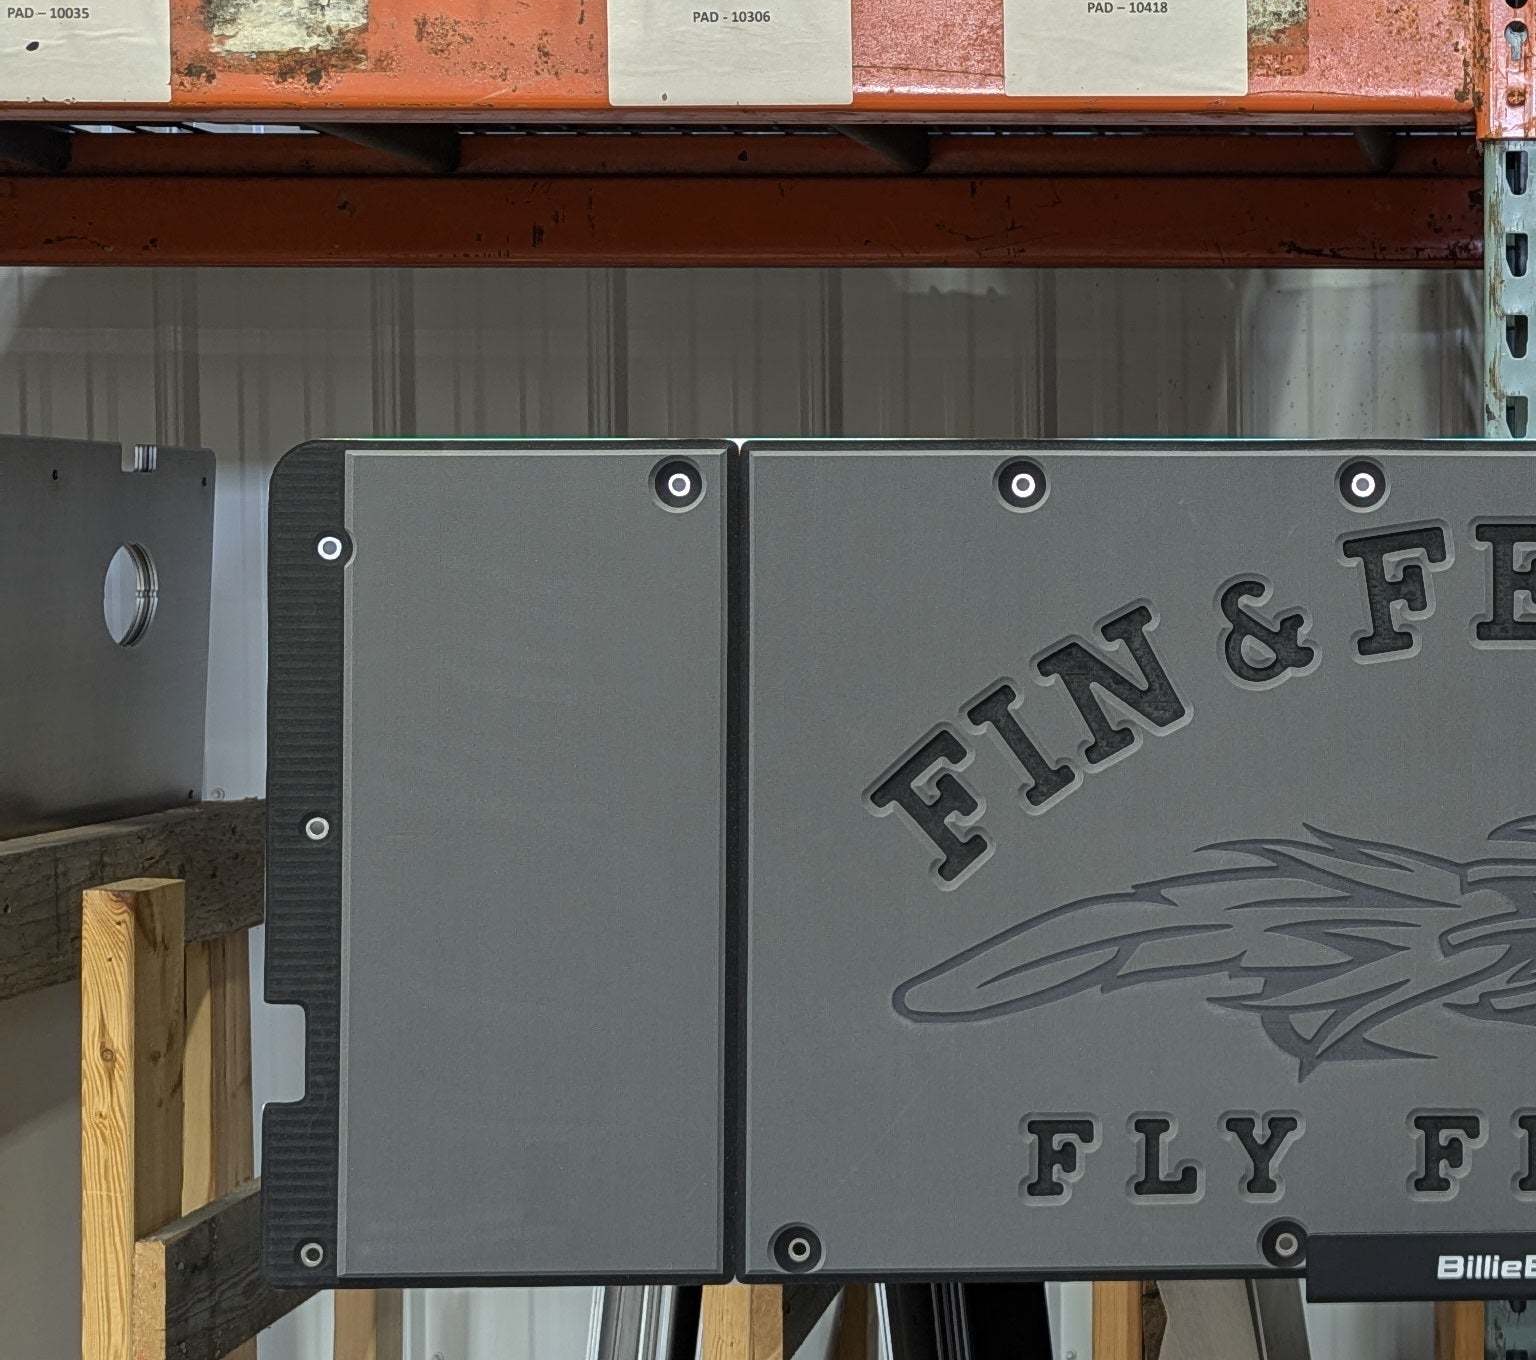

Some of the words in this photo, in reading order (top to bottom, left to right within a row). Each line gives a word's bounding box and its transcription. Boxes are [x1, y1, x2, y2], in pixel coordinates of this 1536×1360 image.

[7, 7, 35, 19] PAD
[49, 7, 90, 20] 10035
[1087, 1, 1114, 14] PAD
[1129, 1, 1168, 14] 10418
[692, 11, 720, 23] PAD
[731, 10, 771, 23] 10306
[864, 599, 1192, 889] FIN
[1217, 576, 1320, 688] &
[1023, 1114, 1302, 1200] FLY
